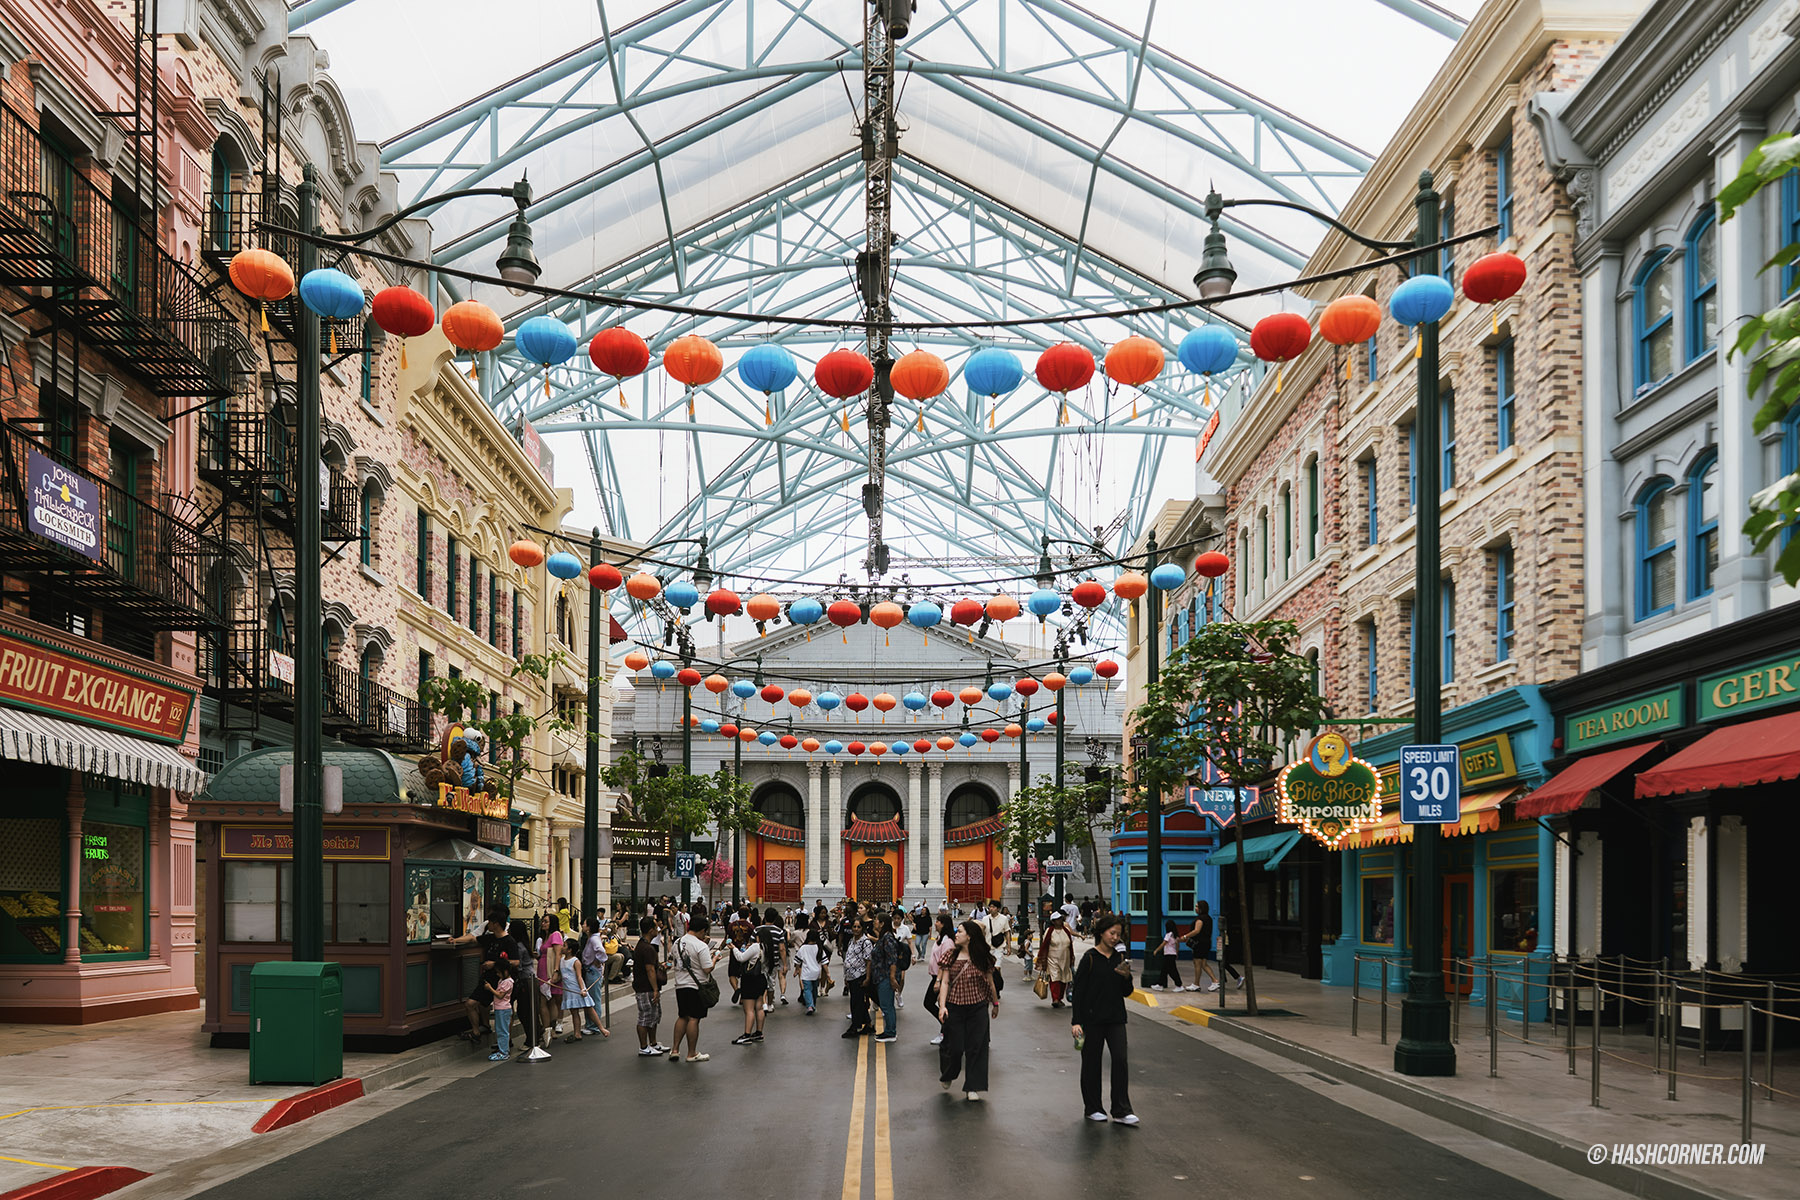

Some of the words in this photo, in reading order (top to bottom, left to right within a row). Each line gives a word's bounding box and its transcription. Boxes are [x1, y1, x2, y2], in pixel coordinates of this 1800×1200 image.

[52, 466, 79, 493] JOHN
[39, 507, 92, 543] LOCKSMITH
[45, 528, 55, 538] AND
[55, 531, 67, 543] BELL
[67, 536, 85, 552] HANGER
[0, 649, 64, 697] FRUIT
[63, 668, 166, 724] EXCHANGE
[1712, 660, 1800, 709] GER
[169, 706, 183, 721] 102
[1576, 718, 1609, 740] TEA
[1612, 699, 1670, 731] ROOM
[1404, 751, 1432, 764] SPEED
[1433, 751, 1455, 763] LIMIT
[1465, 750, 1497, 773] GIFTS
[1410, 766, 1450, 801] 30
[1204, 790, 1247, 802] NEWS
[1287, 803, 1376, 818] EMPORIUM
[1418, 805, 1442, 816] MILES
[250, 834, 273, 849] Me
[679, 858, 692, 871] 30
